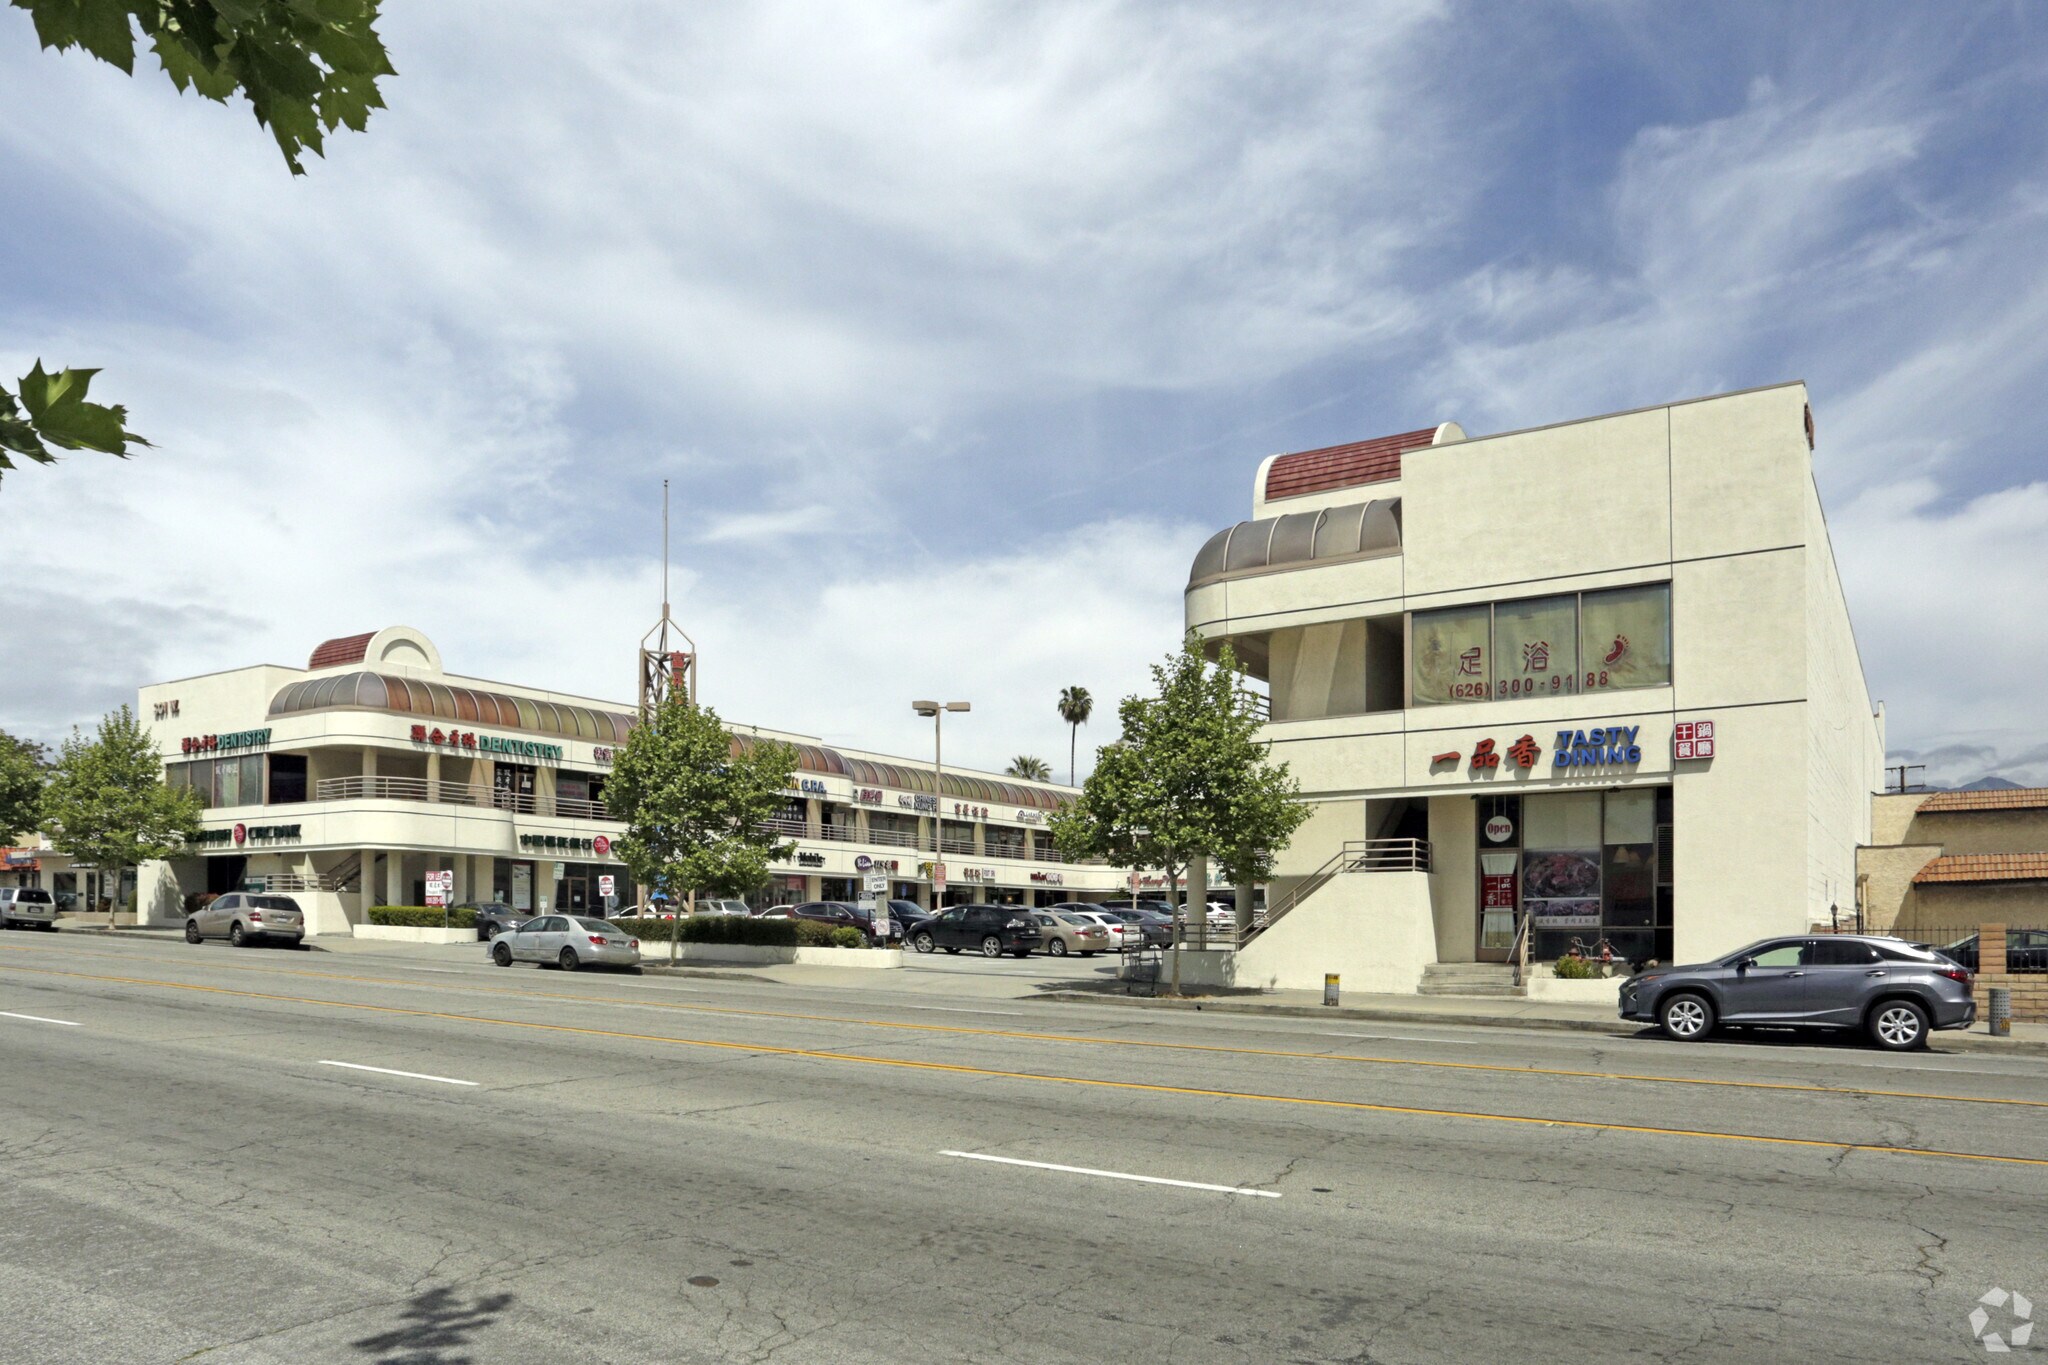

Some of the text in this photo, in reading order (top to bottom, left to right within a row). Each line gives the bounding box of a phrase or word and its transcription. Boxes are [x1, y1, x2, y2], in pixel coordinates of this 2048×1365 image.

[1458, 641, 1549, 676] 足浴
[1449, 682, 1490, 698] (626)
[217, 729, 271, 750] DENTISTRY
[479, 735, 563, 760] DENTISTRY
[1557, 726, 1641, 750] TASTY
[1432, 734, 1542, 769] 一品香
[1554, 745, 1642, 768] DINING
[914, 794, 937, 805] CHINES
[1487, 822, 1511, 835] Open
